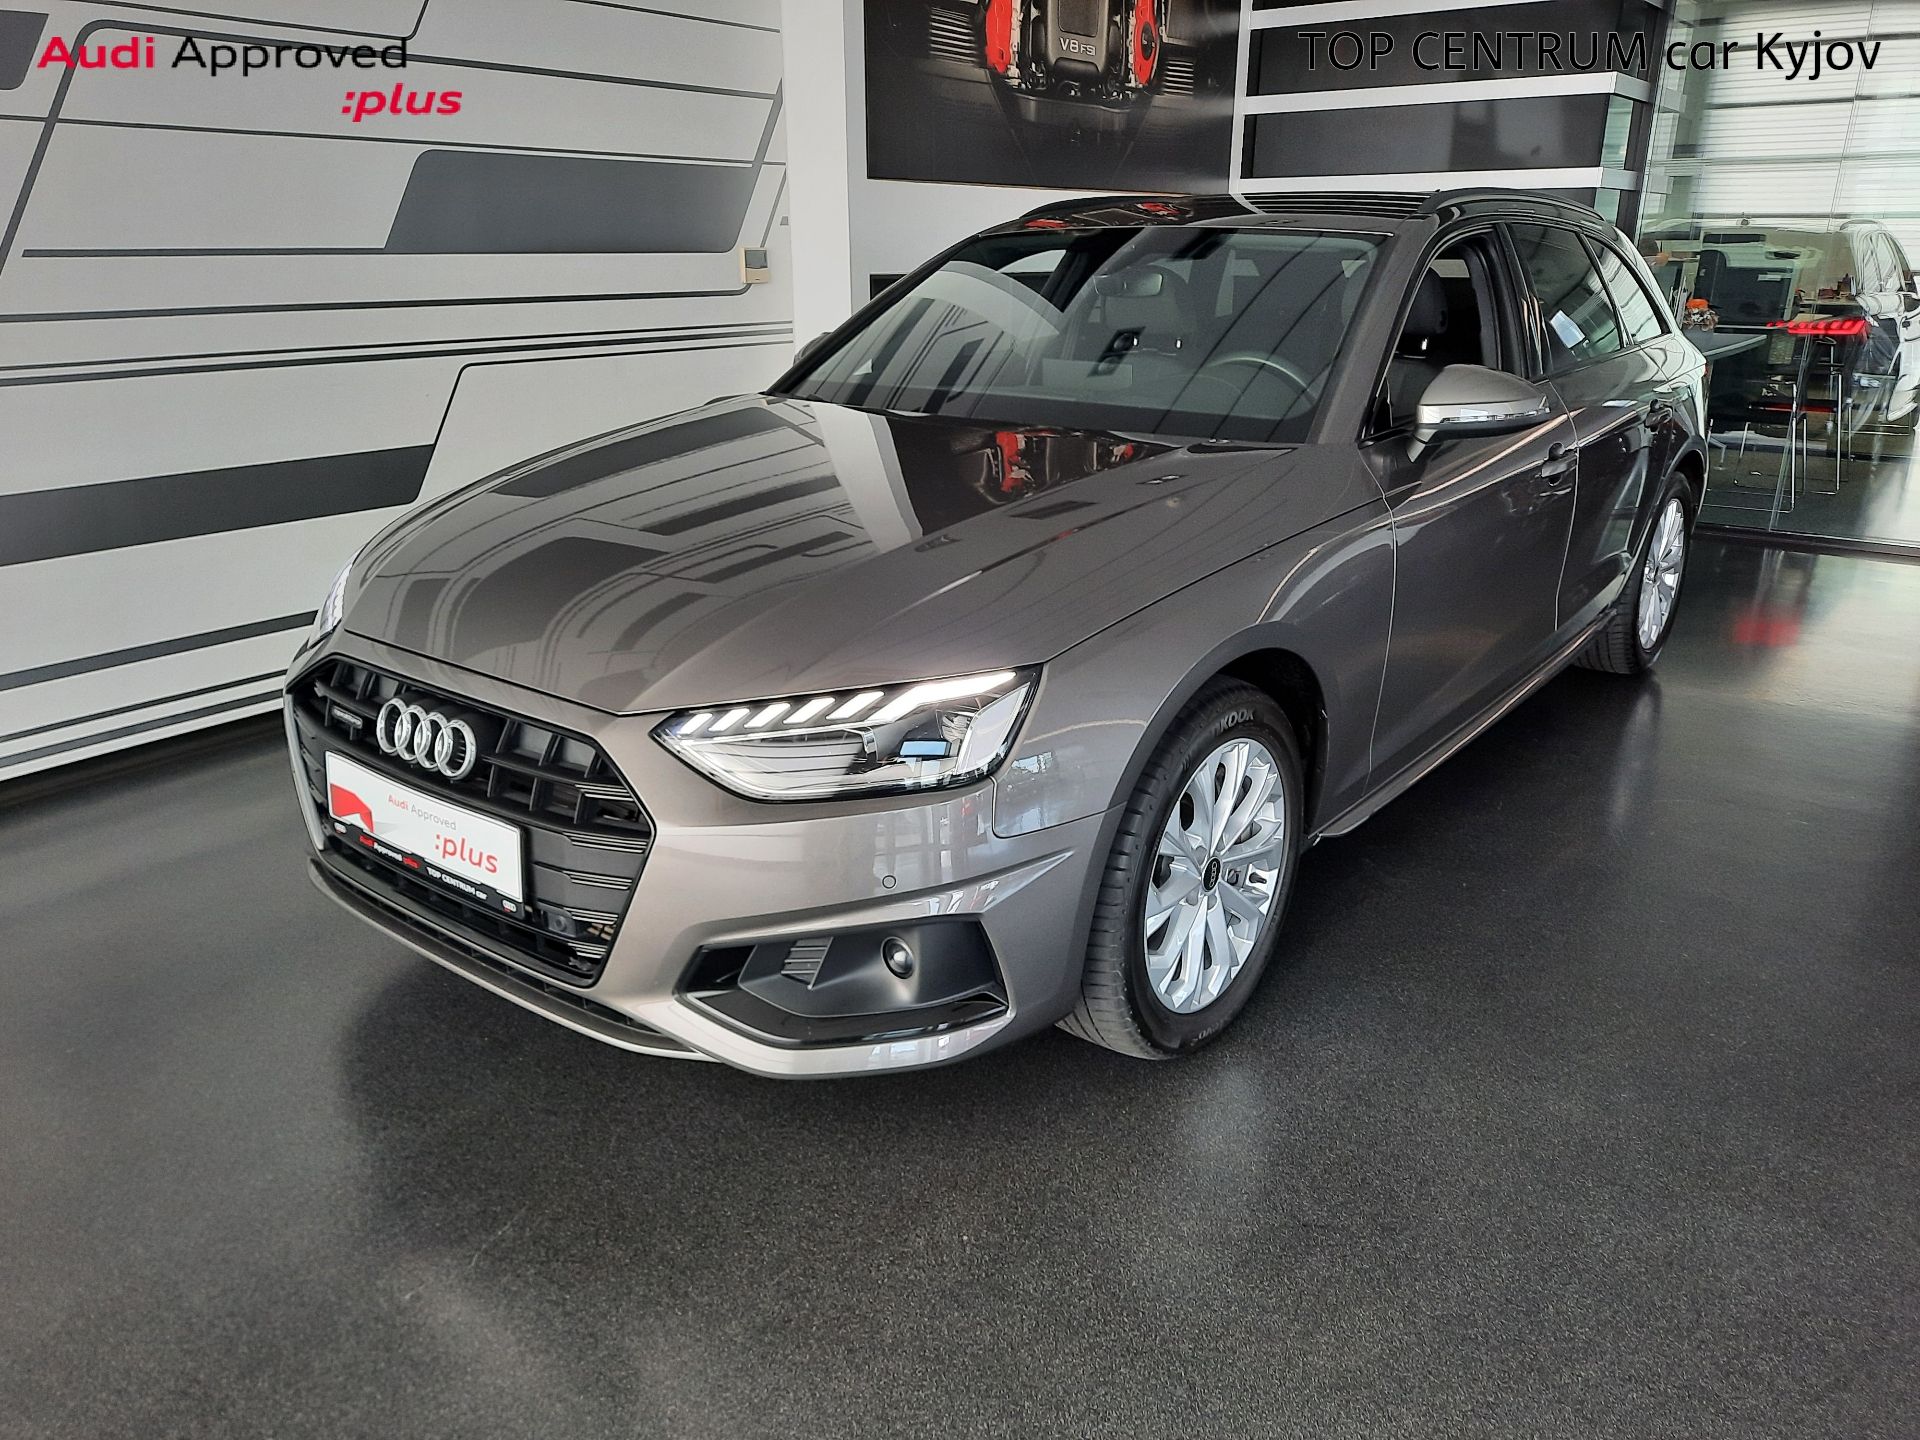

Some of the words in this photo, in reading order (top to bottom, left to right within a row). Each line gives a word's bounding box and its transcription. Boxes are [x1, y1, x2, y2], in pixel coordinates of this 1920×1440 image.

[1060, 37, 1079, 53] V8
[388, 794, 409, 811] Audi
[411, 804, 457, 831] Approved
[435, 834, 498, 874] :plus
